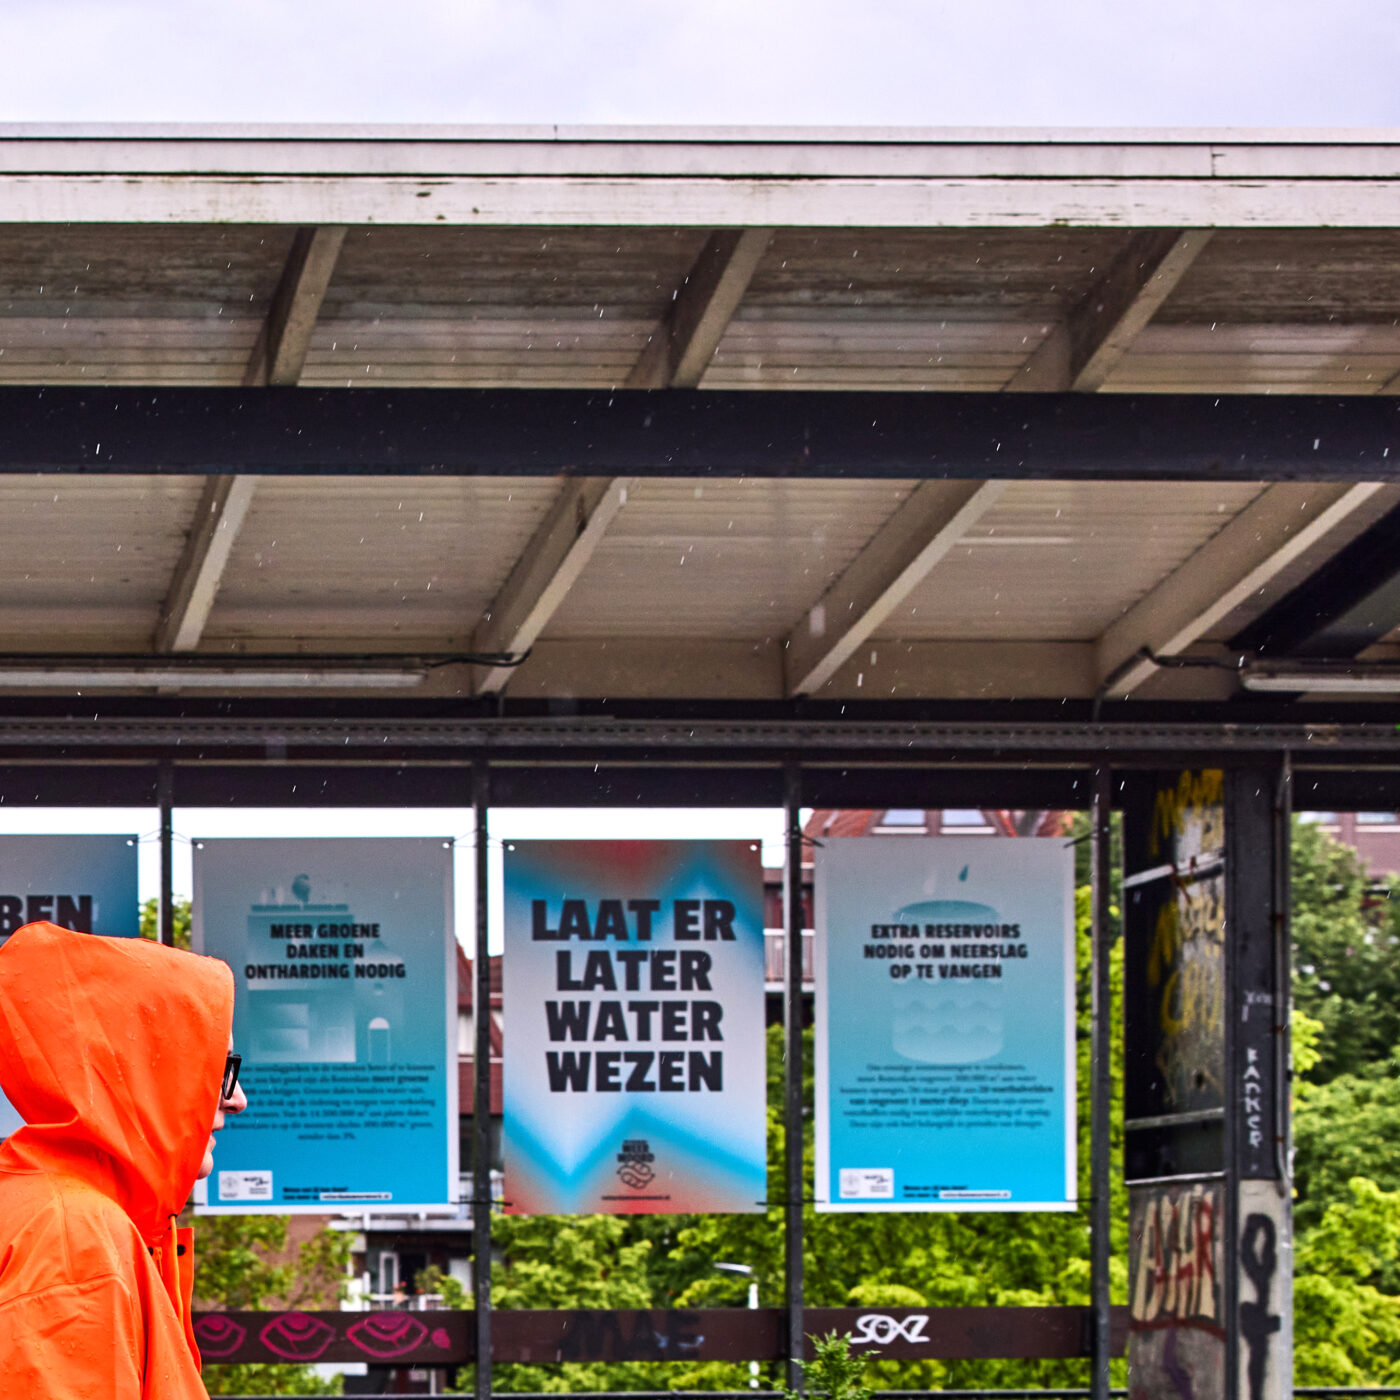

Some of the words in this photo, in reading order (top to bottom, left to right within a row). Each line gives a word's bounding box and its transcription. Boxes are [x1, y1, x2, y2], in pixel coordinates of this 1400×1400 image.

[532, 900, 660, 941] LAAT
[674, 900, 736, 941] ER
[270, 924, 313, 939] MEER
[317, 923, 380, 938] GROENE
[871, 924, 920, 939] EXTRA
[925, 923, 1020, 939] RESERVOIRS
[286, 943, 339, 959] DAKEN
[344, 943, 364, 958] EN
[864, 944, 915, 959] NODIG
[919, 944, 945, 959] OM
[950, 944, 1028, 959] NEERSLAG
[244, 964, 350, 979] ONTHARDING
[354, 963, 406, 979] NODIG
[557, 950, 712, 991] LATER
[889, 964, 912, 979] OP
[916, 964, 933, 979] TE
[938, 964, 1002, 979] VANGEN
[545, 1001, 724, 1041] WATER
[546, 1051, 723, 1092] WEZEN
